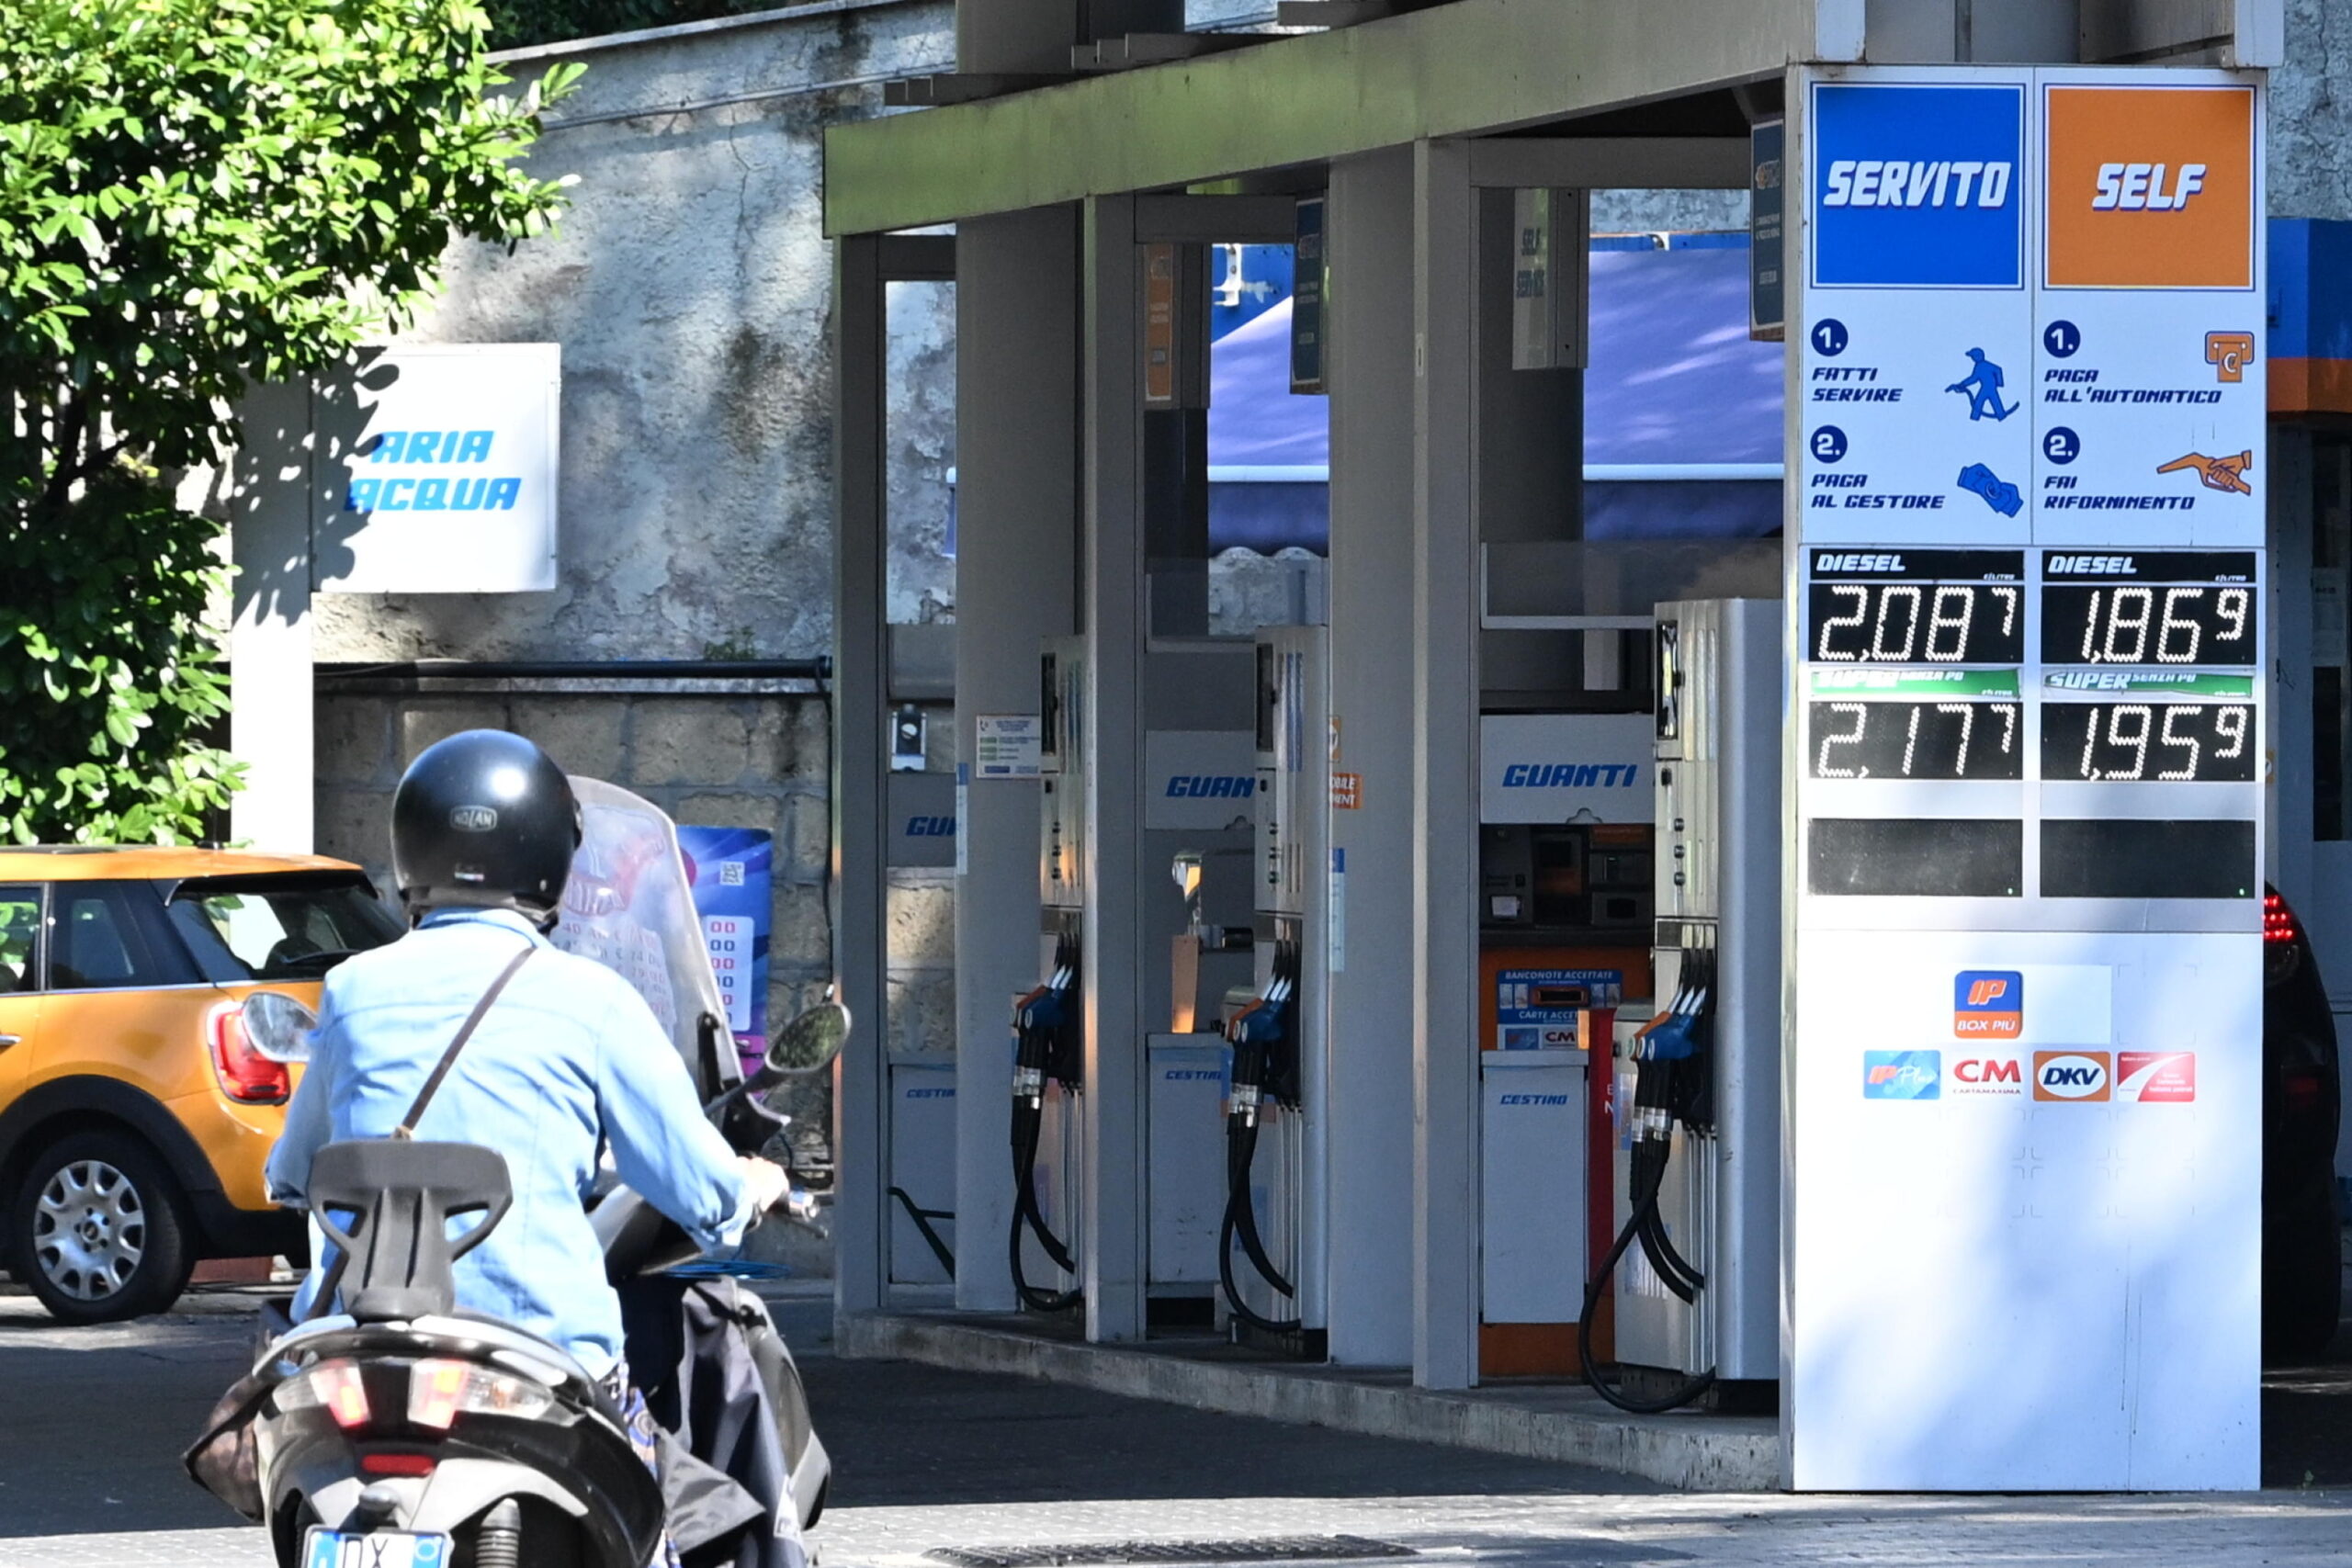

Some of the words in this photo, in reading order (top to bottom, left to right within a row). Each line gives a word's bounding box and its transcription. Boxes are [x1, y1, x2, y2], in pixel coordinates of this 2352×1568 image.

[1824, 161, 2011, 209] SERVITO
[2092, 163, 2206, 212] SELF
[1812, 367, 1878, 381] FATTI
[2044, 369, 2098, 383] PAGA
[1812, 389, 1903, 402] SERVIRE
[2044, 388, 2222, 403] ALL'AUTOMATICO
[371, 431, 494, 463] ARIA
[1811, 474, 1867, 488] PAGA
[2044, 476, 2077, 489] FAI
[344, 478, 522, 511] ACQUA
[1811, 496, 1838, 509] AL
[1845, 496, 1945, 509] GESTORE
[2044, 496, 2195, 510] RIFORNIMENTO
[1816, 555, 1906, 572] DIESEL
[2047, 556, 2138, 574] DIESEL
[1818, 671, 1899, 688] SUPER
[2050, 672, 2131, 689] SUPER
[1501, 763, 1637, 787] GUANTI
[1967, 979, 2007, 1005] IP
[1957, 1020, 1988, 1032] BOX
[1544, 1031, 1576, 1043] CM
[1953, 1060, 2022, 1084] CM
[2042, 1067, 2100, 1086] DKV
[1500, 1094, 1567, 1105] CESTINO
